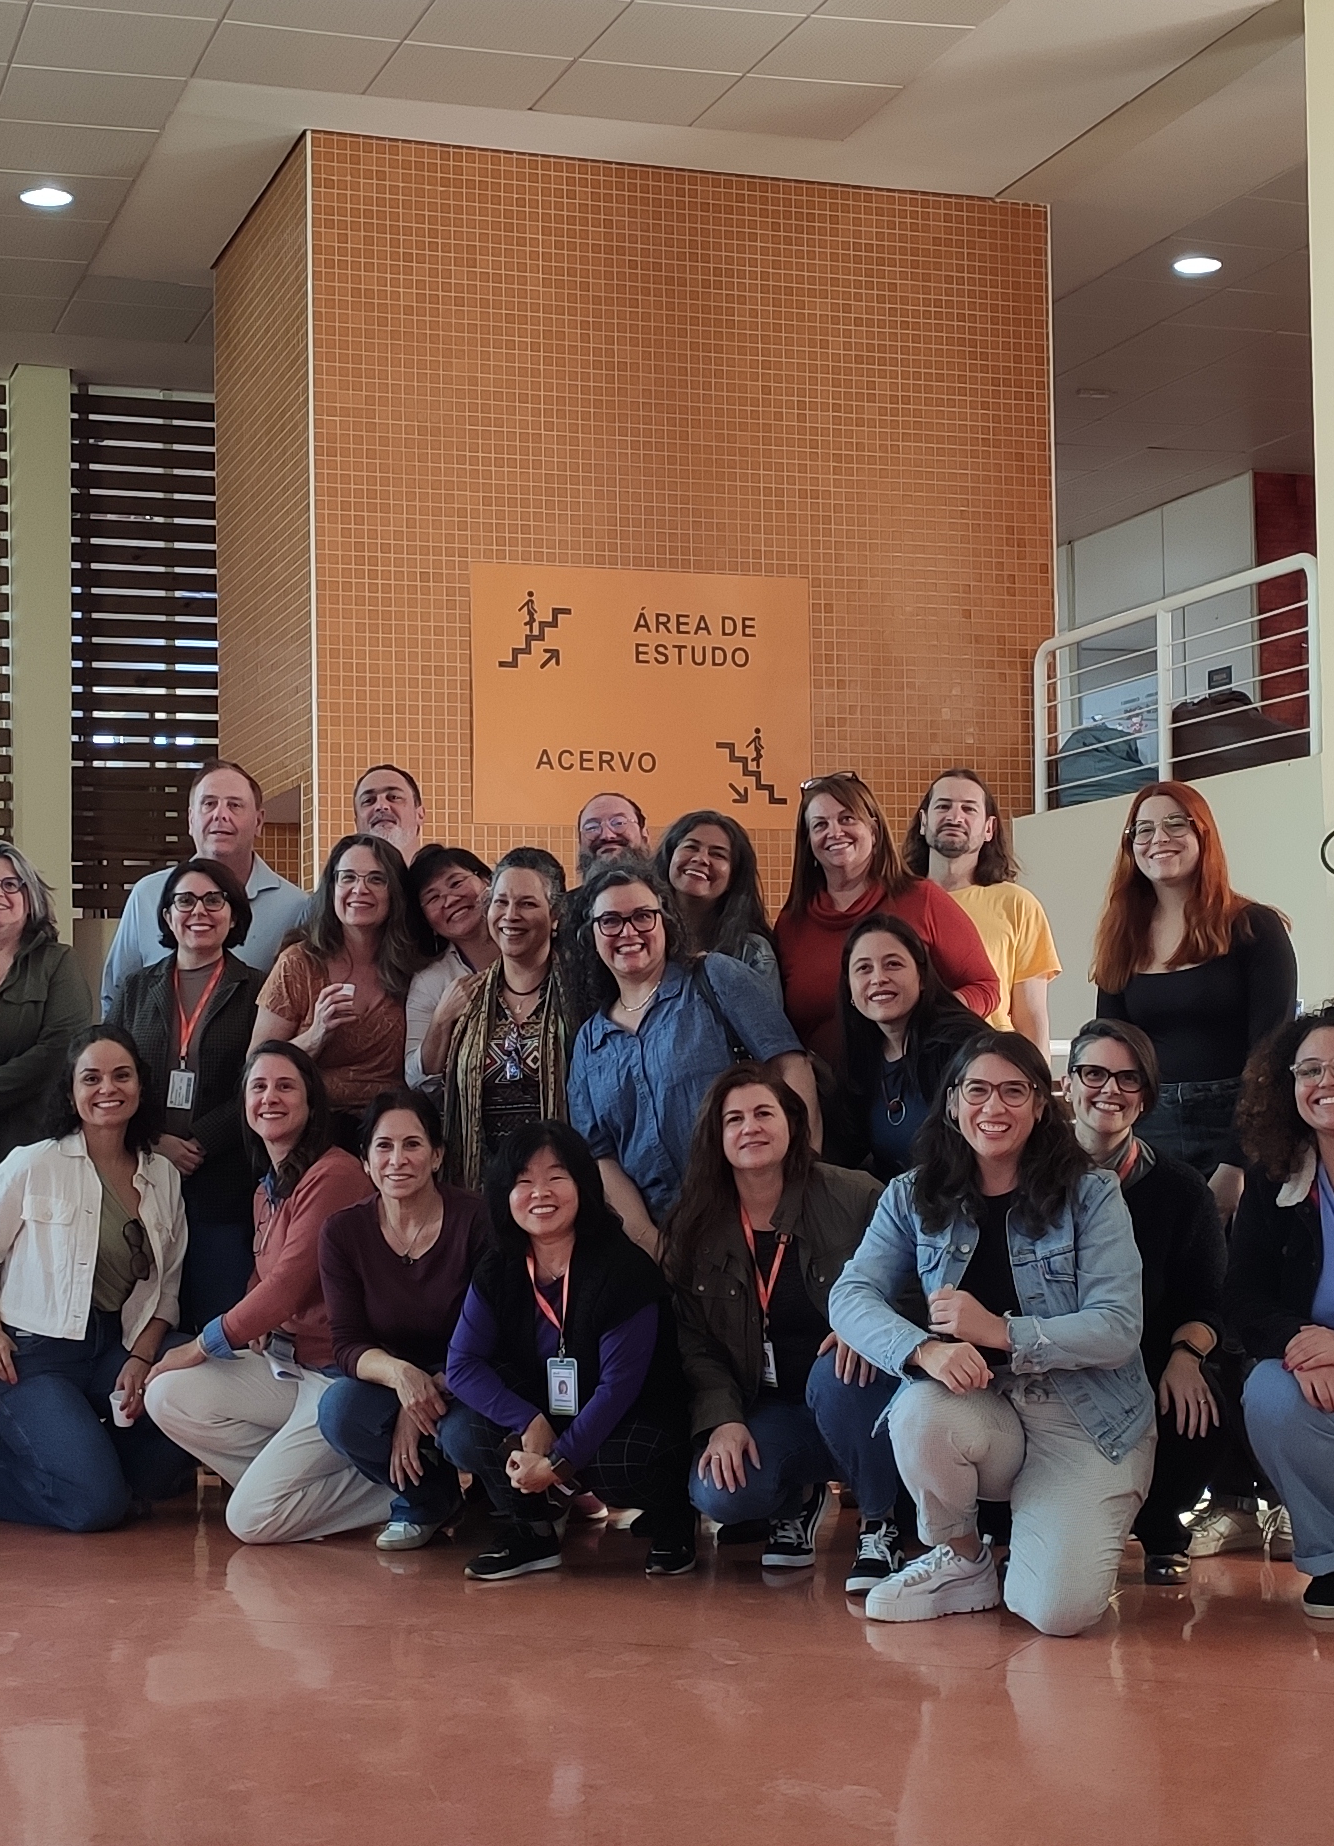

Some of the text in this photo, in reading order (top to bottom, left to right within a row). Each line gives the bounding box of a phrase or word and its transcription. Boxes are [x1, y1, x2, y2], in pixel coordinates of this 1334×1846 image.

[633, 606, 757, 637] ÁREA DE
[634, 643, 750, 668] ESTUDO
[535, 749, 657, 774] ACERVO
